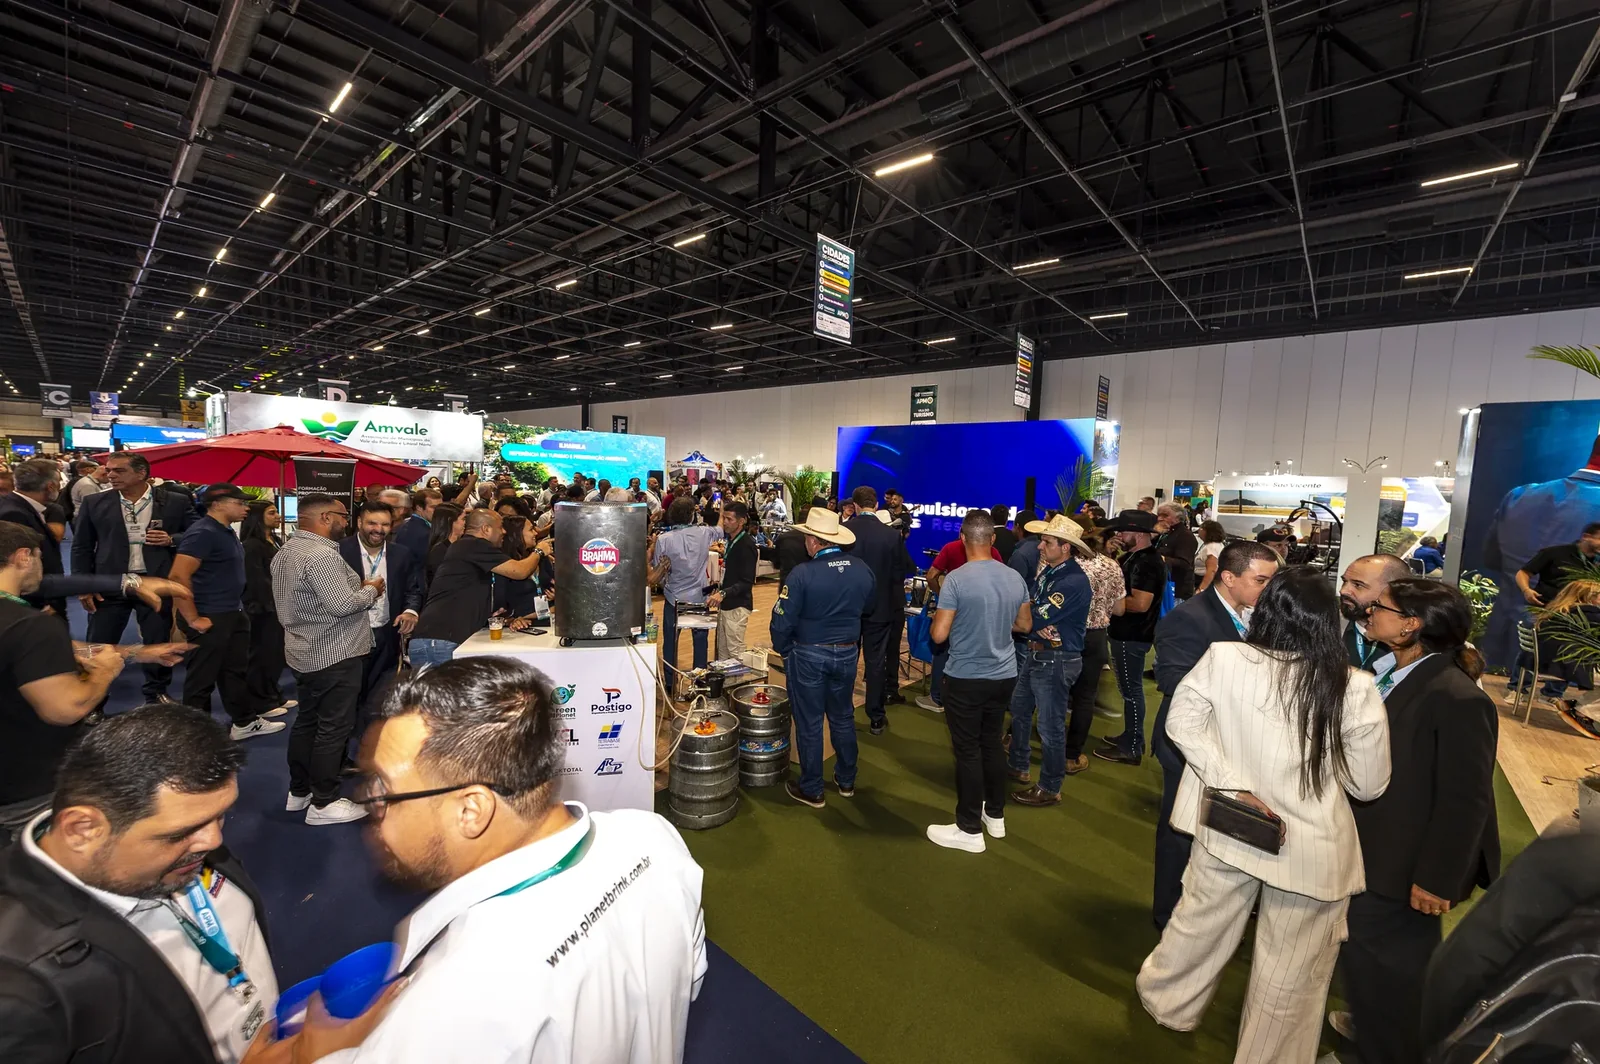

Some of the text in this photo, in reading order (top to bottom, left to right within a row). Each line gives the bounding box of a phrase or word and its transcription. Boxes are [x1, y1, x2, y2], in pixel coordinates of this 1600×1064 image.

[822, 244, 850, 264] CIDADES
[48, 390, 70, 405] C
[327, 386, 348, 402] D
[364, 420, 428, 436] Amvale
[582, 550, 616, 561] BRAHMA
[591, 703, 632, 712] Postigo
[546, 856, 652, 968] www.planetbrink.com.br
